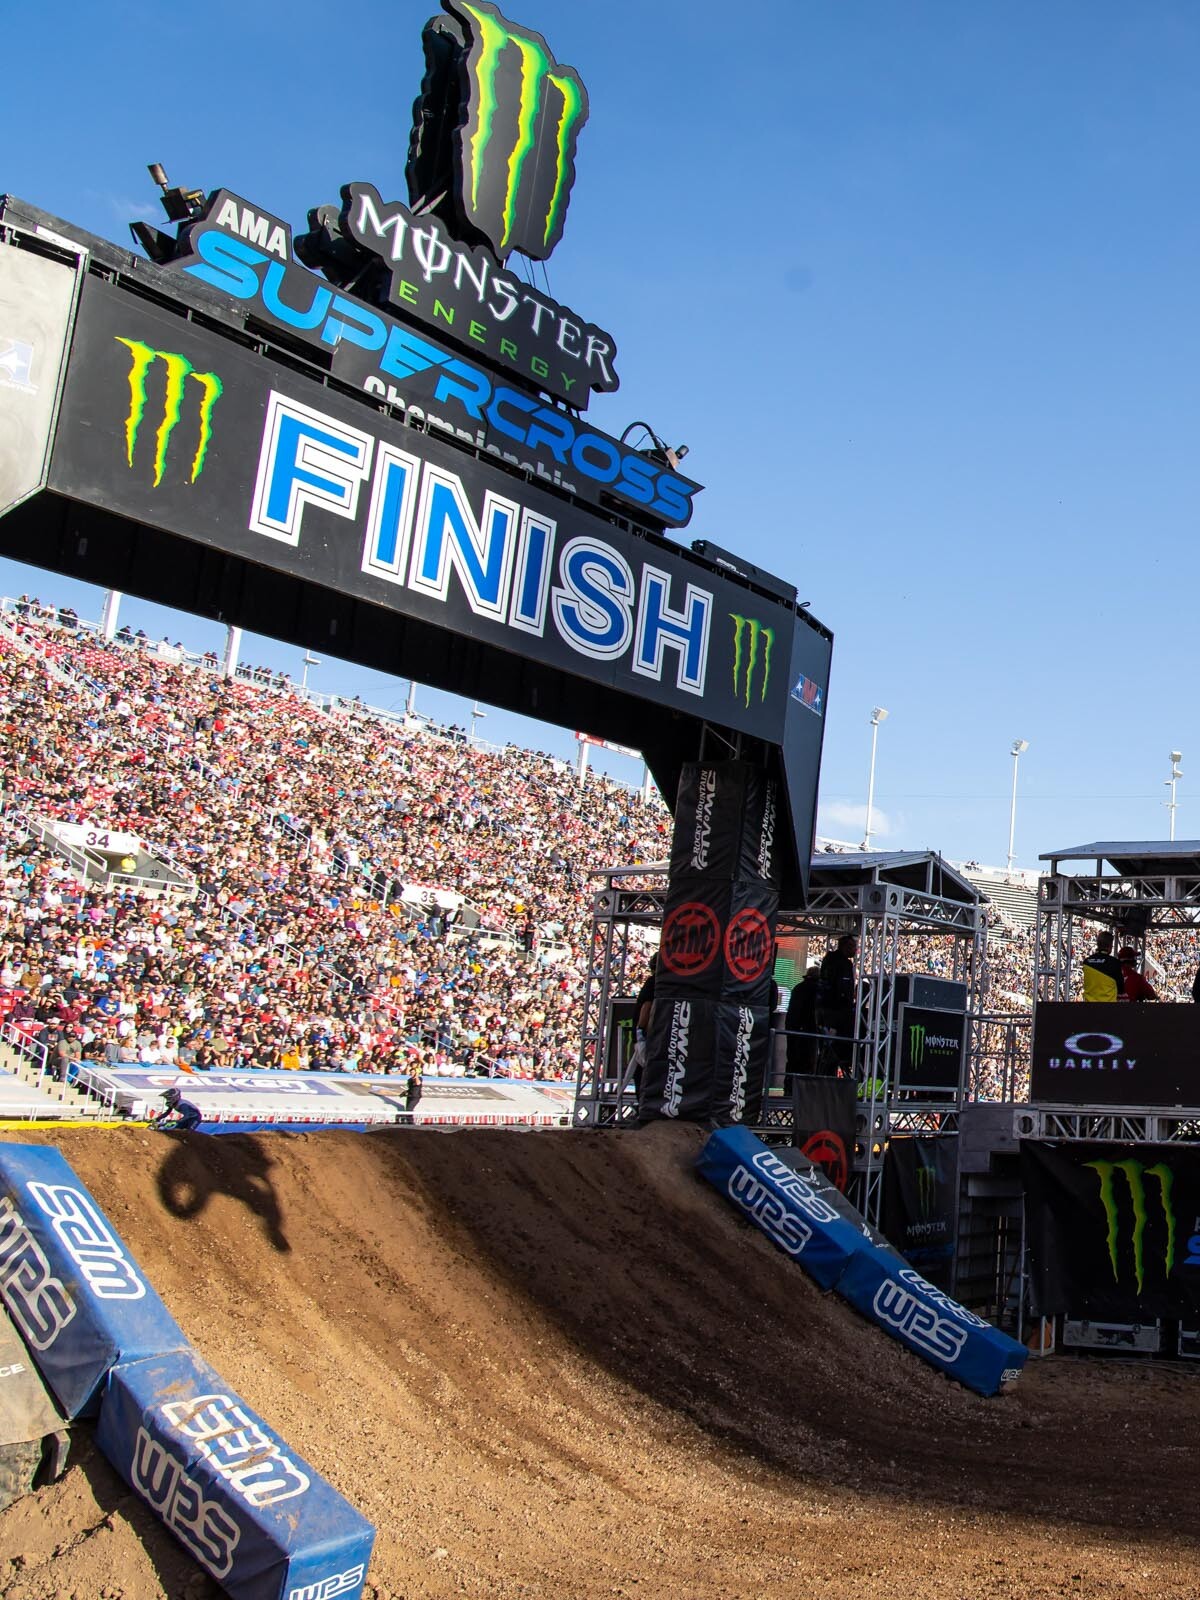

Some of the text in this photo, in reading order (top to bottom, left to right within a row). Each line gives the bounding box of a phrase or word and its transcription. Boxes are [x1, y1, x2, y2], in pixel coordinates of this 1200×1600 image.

[216, 199, 288, 260] AMA
[357, 194, 612, 384] MONSTER
[399, 279, 576, 391] ENERGY
[182, 230, 693, 522] SUPERCROSS
[249, 389, 714, 697] FINISH
[85, 831, 109, 848] 34
[692, 770, 708, 854] ROCKY MOUNTAIN
[663, 1001, 682, 1100] ROCKY MOUNTAIN
[729, 1006, 745, 1103] ROCKY MOUNTAIN
[925, 1035, 960, 1049] MONSTER
[1050, 1058, 1137, 1070] OAKLEY
[728, 1165, 813, 1254] WPS
[752, 1151, 840, 1222] WPS
[26, 1181, 145, 1300] WPS
[873, 1279, 968, 1363] WPS
[132, 1425, 241, 1579] WPS
